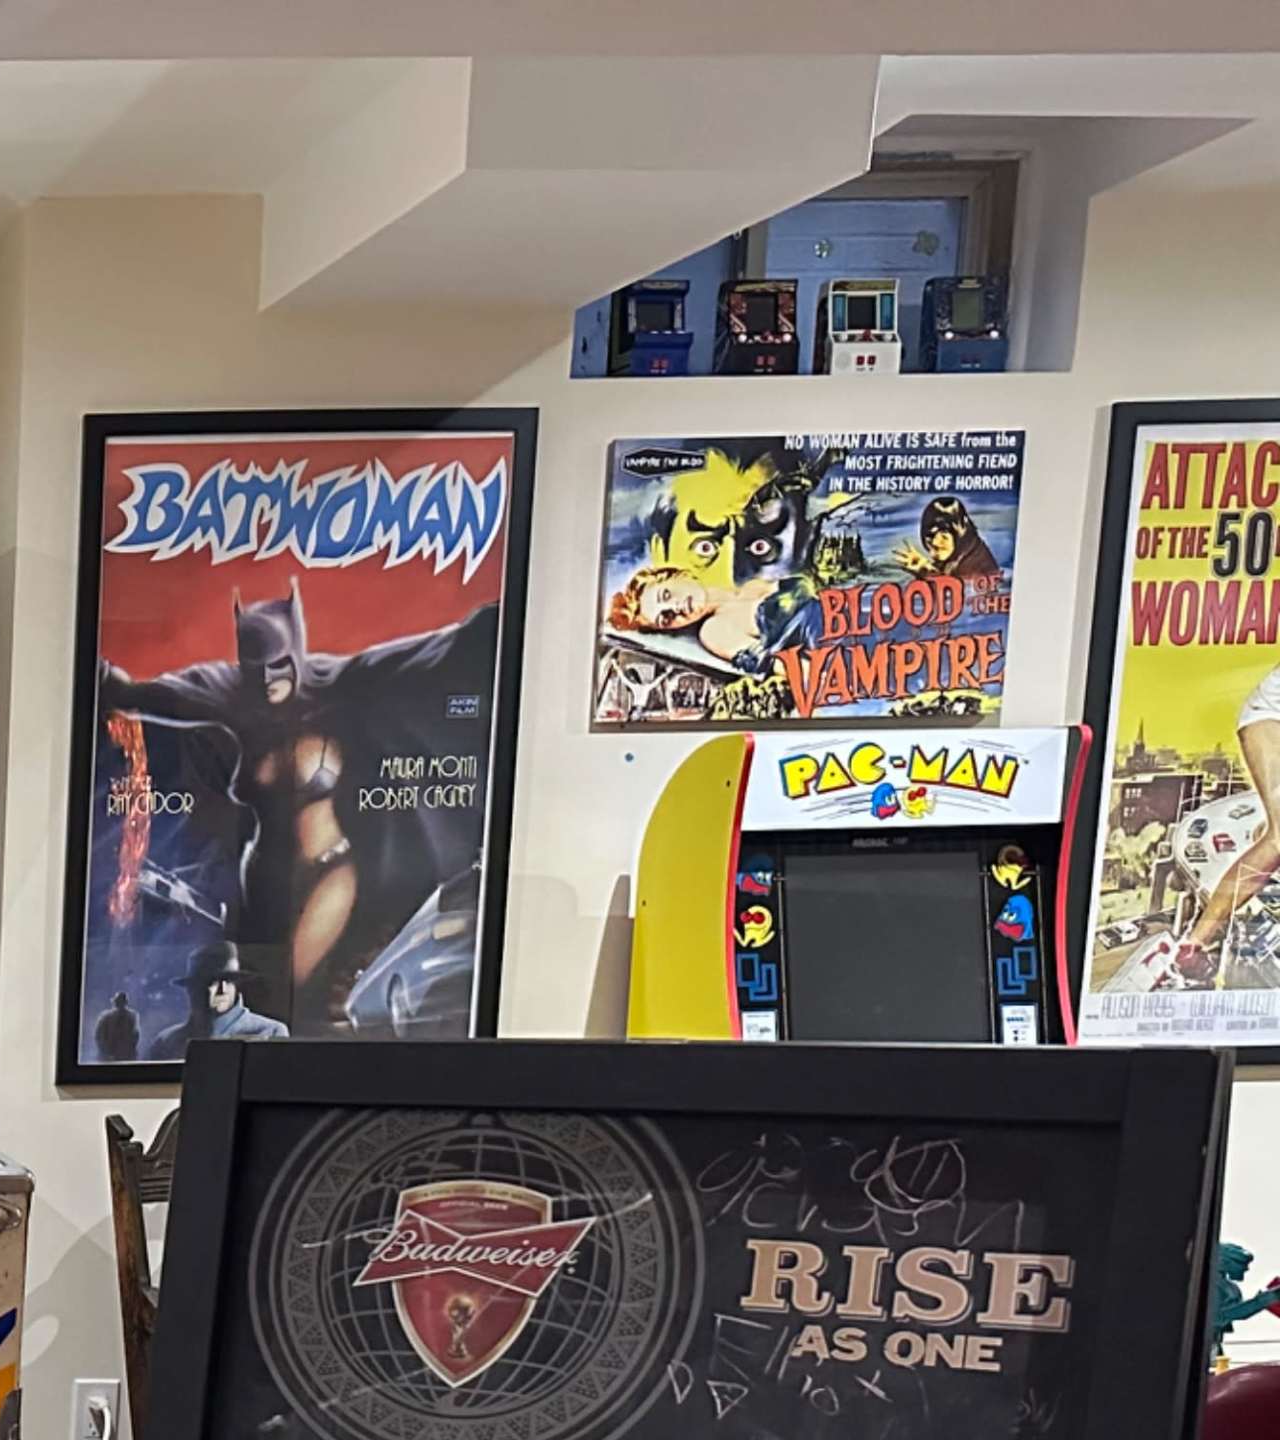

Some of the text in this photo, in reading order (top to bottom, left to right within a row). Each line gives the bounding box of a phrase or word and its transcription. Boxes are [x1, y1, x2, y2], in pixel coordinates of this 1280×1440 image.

[785, 431, 1017, 449] NO WOMAN ALIVE IS SAFE from the
[845, 453, 1018, 470] MOST FRIGHTENING FIEND
[829, 474, 1014, 492] IN THE HISTORY OF HORROR!
[105, 456, 507, 584] BATWOMAN
[1135, 512, 1273, 577] OF THE 50
[969, 595, 1011, 615] THE
[972, 573, 1004, 594] OF
[818, 575, 964, 642] BLOOD
[775, 631, 1005, 719] VAMPIRE
[380, 756, 425, 779] MAURA
[779, 741, 1020, 800] PAC-MAN
[358, 786, 418, 811] ROBERT
[345, 1226, 580, 1270] Budweiser
[741, 1239, 1076, 1332] RISE
[792, 1325, 1003, 1373] AS ONE
